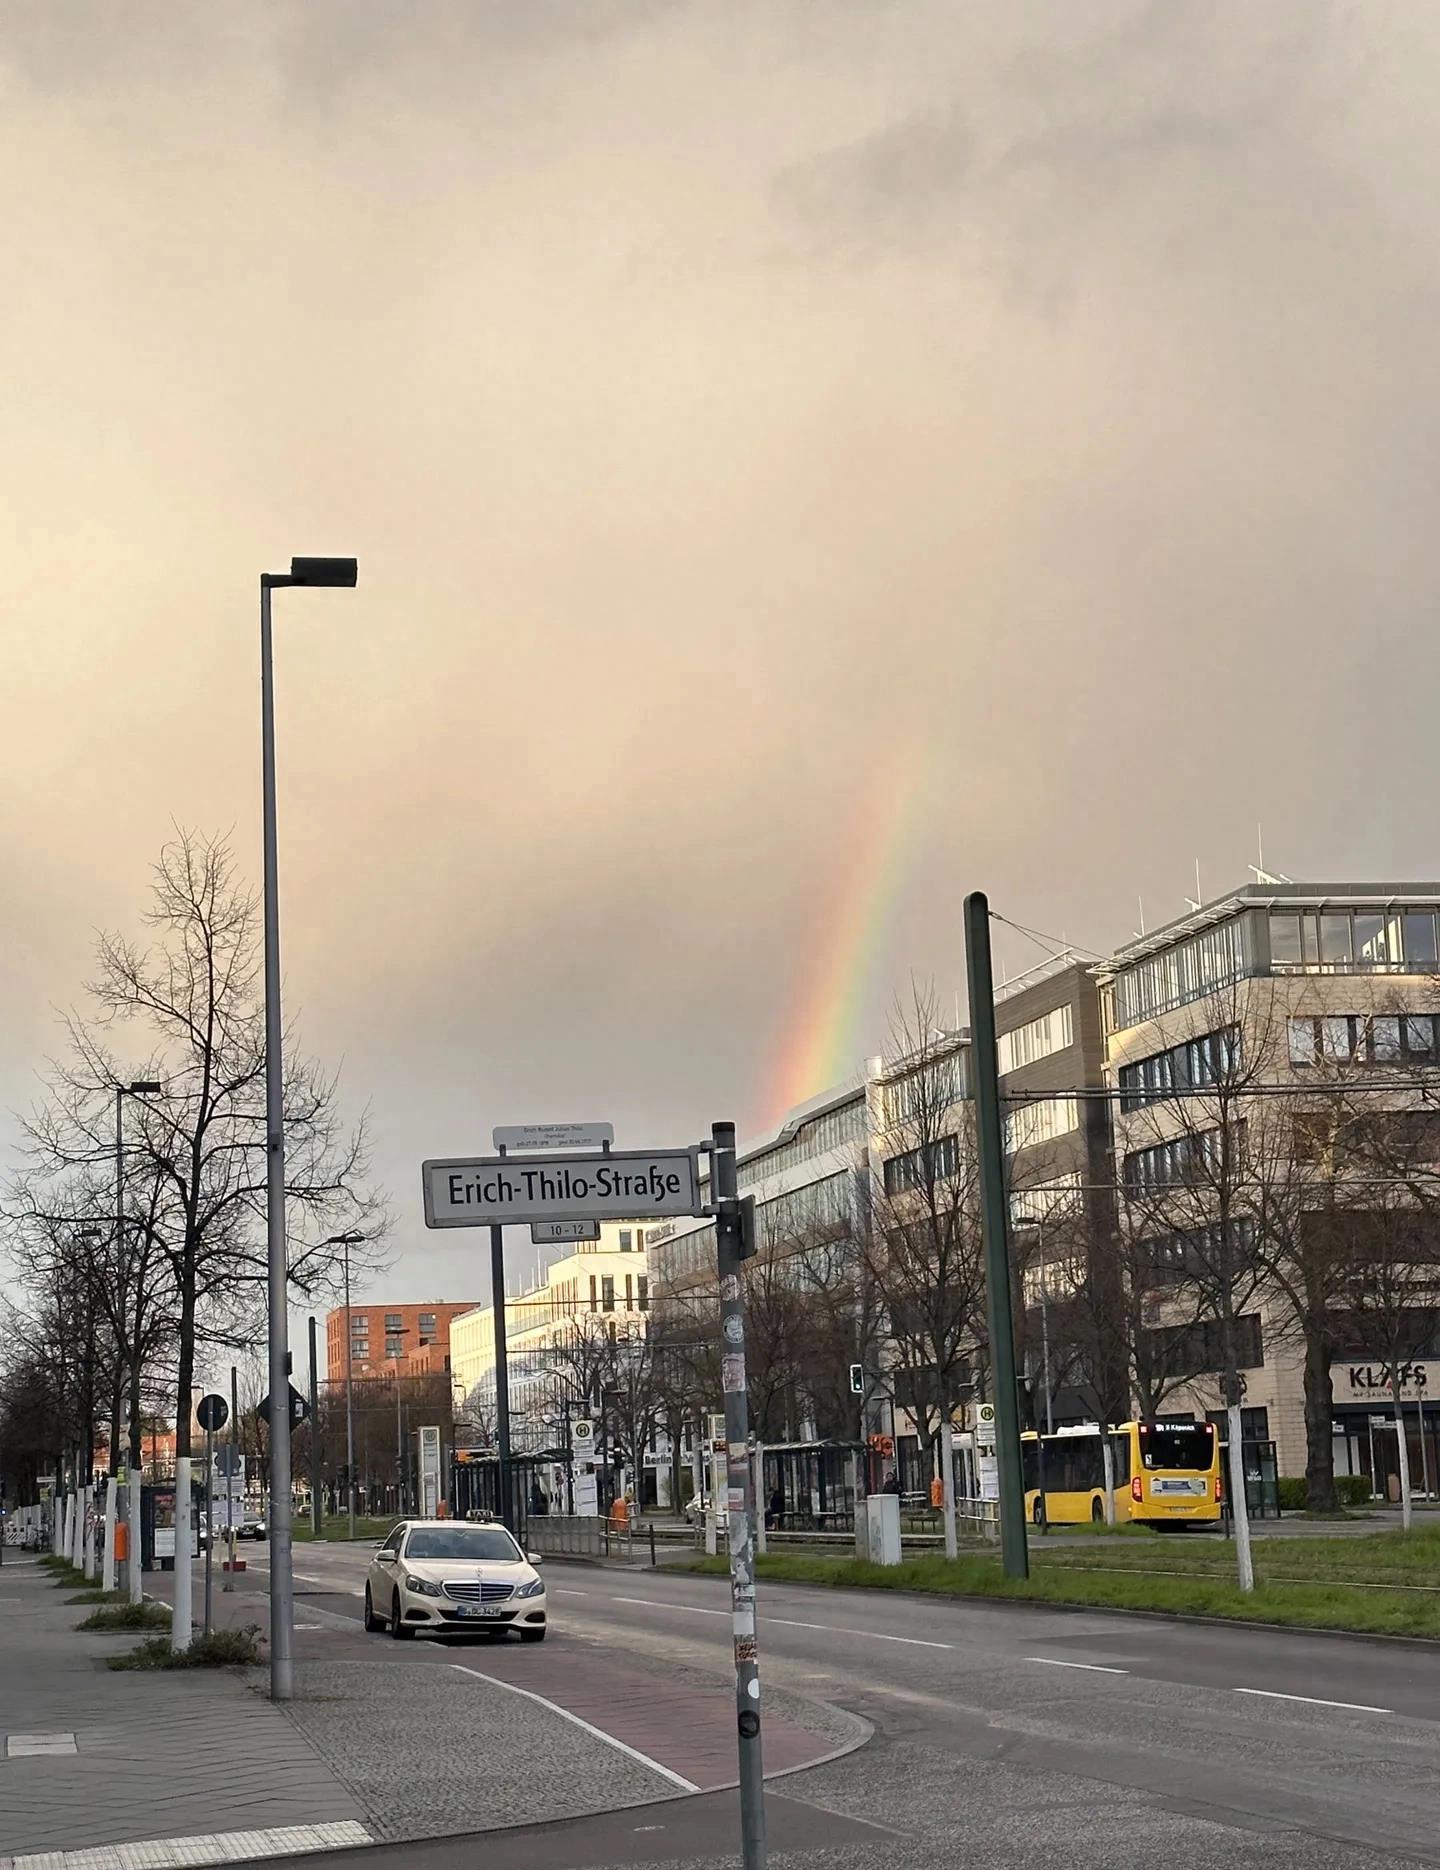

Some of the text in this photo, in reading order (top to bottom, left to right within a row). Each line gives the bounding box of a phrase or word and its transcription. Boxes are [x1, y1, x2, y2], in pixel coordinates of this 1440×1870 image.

[449, 1165, 681, 1205] Erich-Thilo-Straße
[550, 1225, 562, 1236] 10
[572, 1224, 584, 1235] 12
[645, 1454, 672, 1465] Berlin
